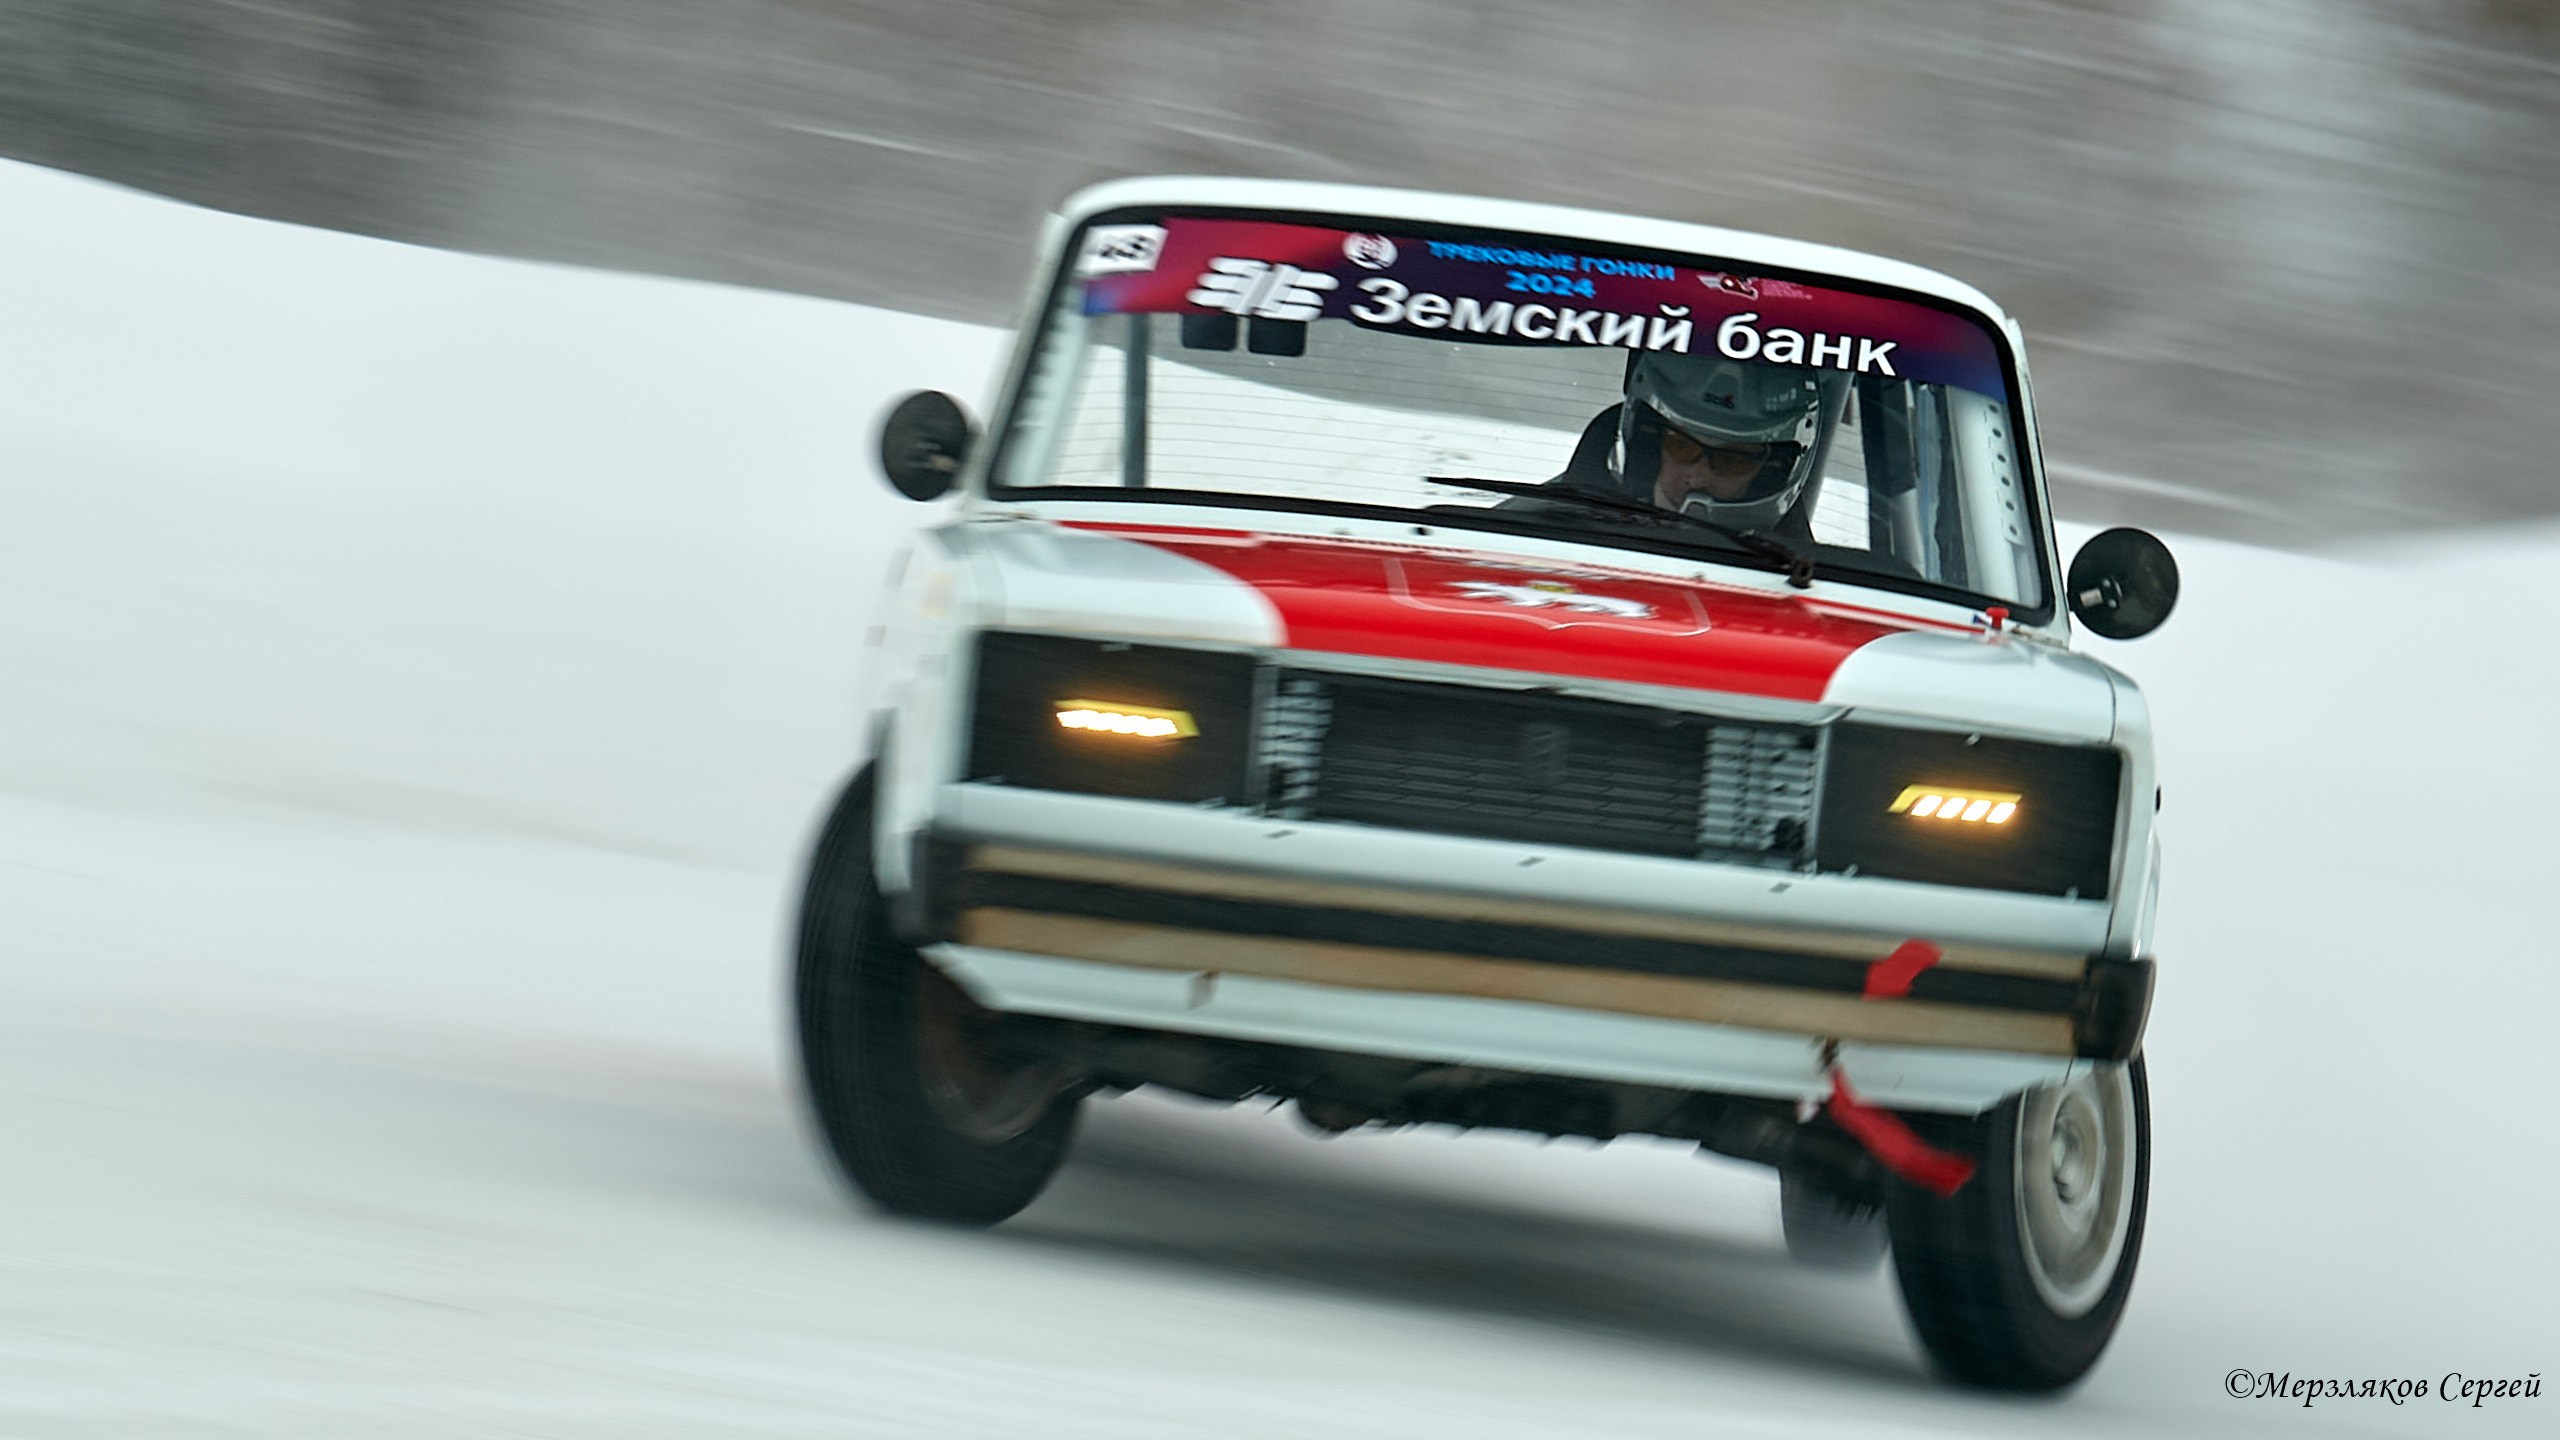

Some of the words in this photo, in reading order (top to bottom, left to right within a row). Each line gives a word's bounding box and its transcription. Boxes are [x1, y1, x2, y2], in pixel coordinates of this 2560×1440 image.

[1426, 241, 1576, 272] ТРЕКОВЫЕ
[1579, 255, 1676, 281] ГОНКИ
[1504, 270, 1597, 299] 2024
[1349, 277, 1695, 354] Земский
[1715, 312, 1898, 377] банк
